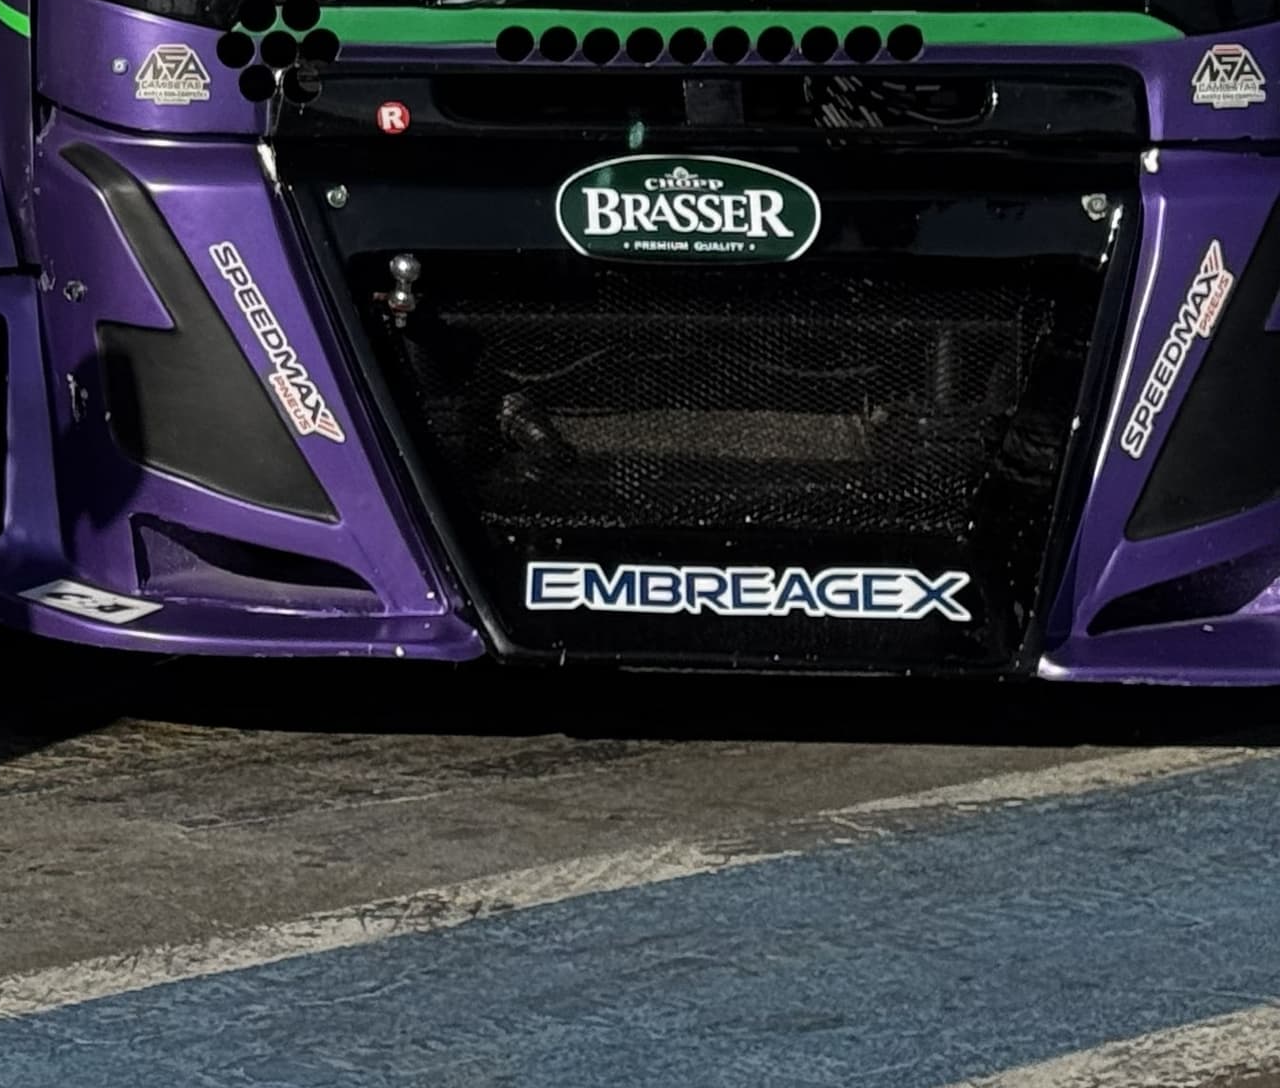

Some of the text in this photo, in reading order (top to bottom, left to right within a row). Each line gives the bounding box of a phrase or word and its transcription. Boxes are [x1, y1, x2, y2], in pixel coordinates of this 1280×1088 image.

[380, 106, 406, 129] R
[645, 176, 724, 192] CHOPP
[582, 187, 794, 240] BRASSER
[633, 241, 745, 253] PREMIUM QUALITY
[269, 374, 314, 433] PNEUS
[526, 561, 971, 621] EMBREAGEX
